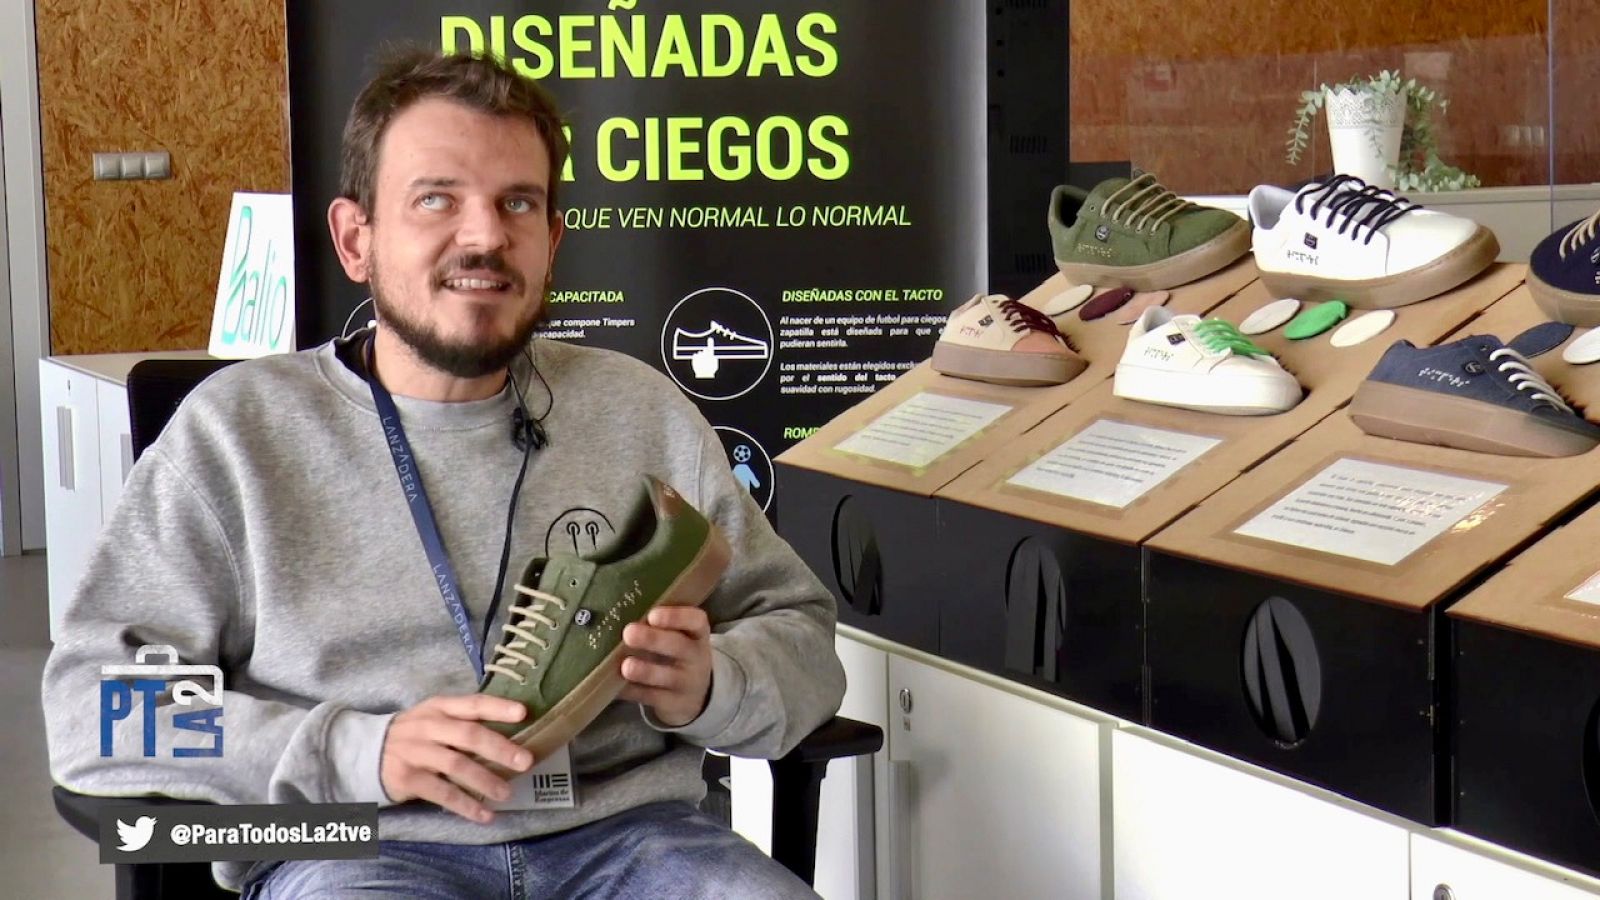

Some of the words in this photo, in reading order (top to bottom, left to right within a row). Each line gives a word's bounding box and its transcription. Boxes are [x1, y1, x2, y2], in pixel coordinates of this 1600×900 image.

[441, 0, 838, 79] DISEÑADAS
[596, 115, 850, 182] CIEGOS
[564, 207, 613, 231] QUE
[618, 207, 664, 229] VEN
[669, 205, 770, 229] NORMAL
[775, 206, 806, 227] LO
[812, 205, 912, 227] NORMAL
[549, 290, 625, 304] CAPACITADA
[782, 288, 854, 302] DISEÑADAS
[855, 289, 883, 302] CON
[884, 289, 899, 301] EL
[902, 289, 944, 301] TACTO
[563, 319, 601, 330] compone
[602, 317, 636, 328] Timpers
[789, 317, 812, 325] nacer
[813, 315, 824, 325] de
[825, 317, 836, 325] un
[836, 315, 863, 327] equipo
[865, 315, 875, 325] de
[901, 317, 919, 326] para
[780, 328, 814, 338] zapatilla
[821, 327, 839, 336] está
[890, 328, 909, 338] para
[915, 328, 931, 337] que
[780, 339, 815, 350] pudieran
[780, 362, 795, 372] Los
[796, 361, 838, 371] materiales
[839, 360, 861, 371] están
[863, 360, 895, 372] elegidos
[780, 375, 795, 384] por
[801, 373, 810, 383] el
[817, 372, 847, 382] sentido
[855, 372, 868, 382] del
[875, 373, 896, 382] tacto
[780, 385, 817, 395] suavidad
[818, 386, 834, 394] con
[835, 384, 876, 396] rugosidad.
[383, 416, 418, 502] LANZADERA
[433, 564, 473, 655] LANZADERA
